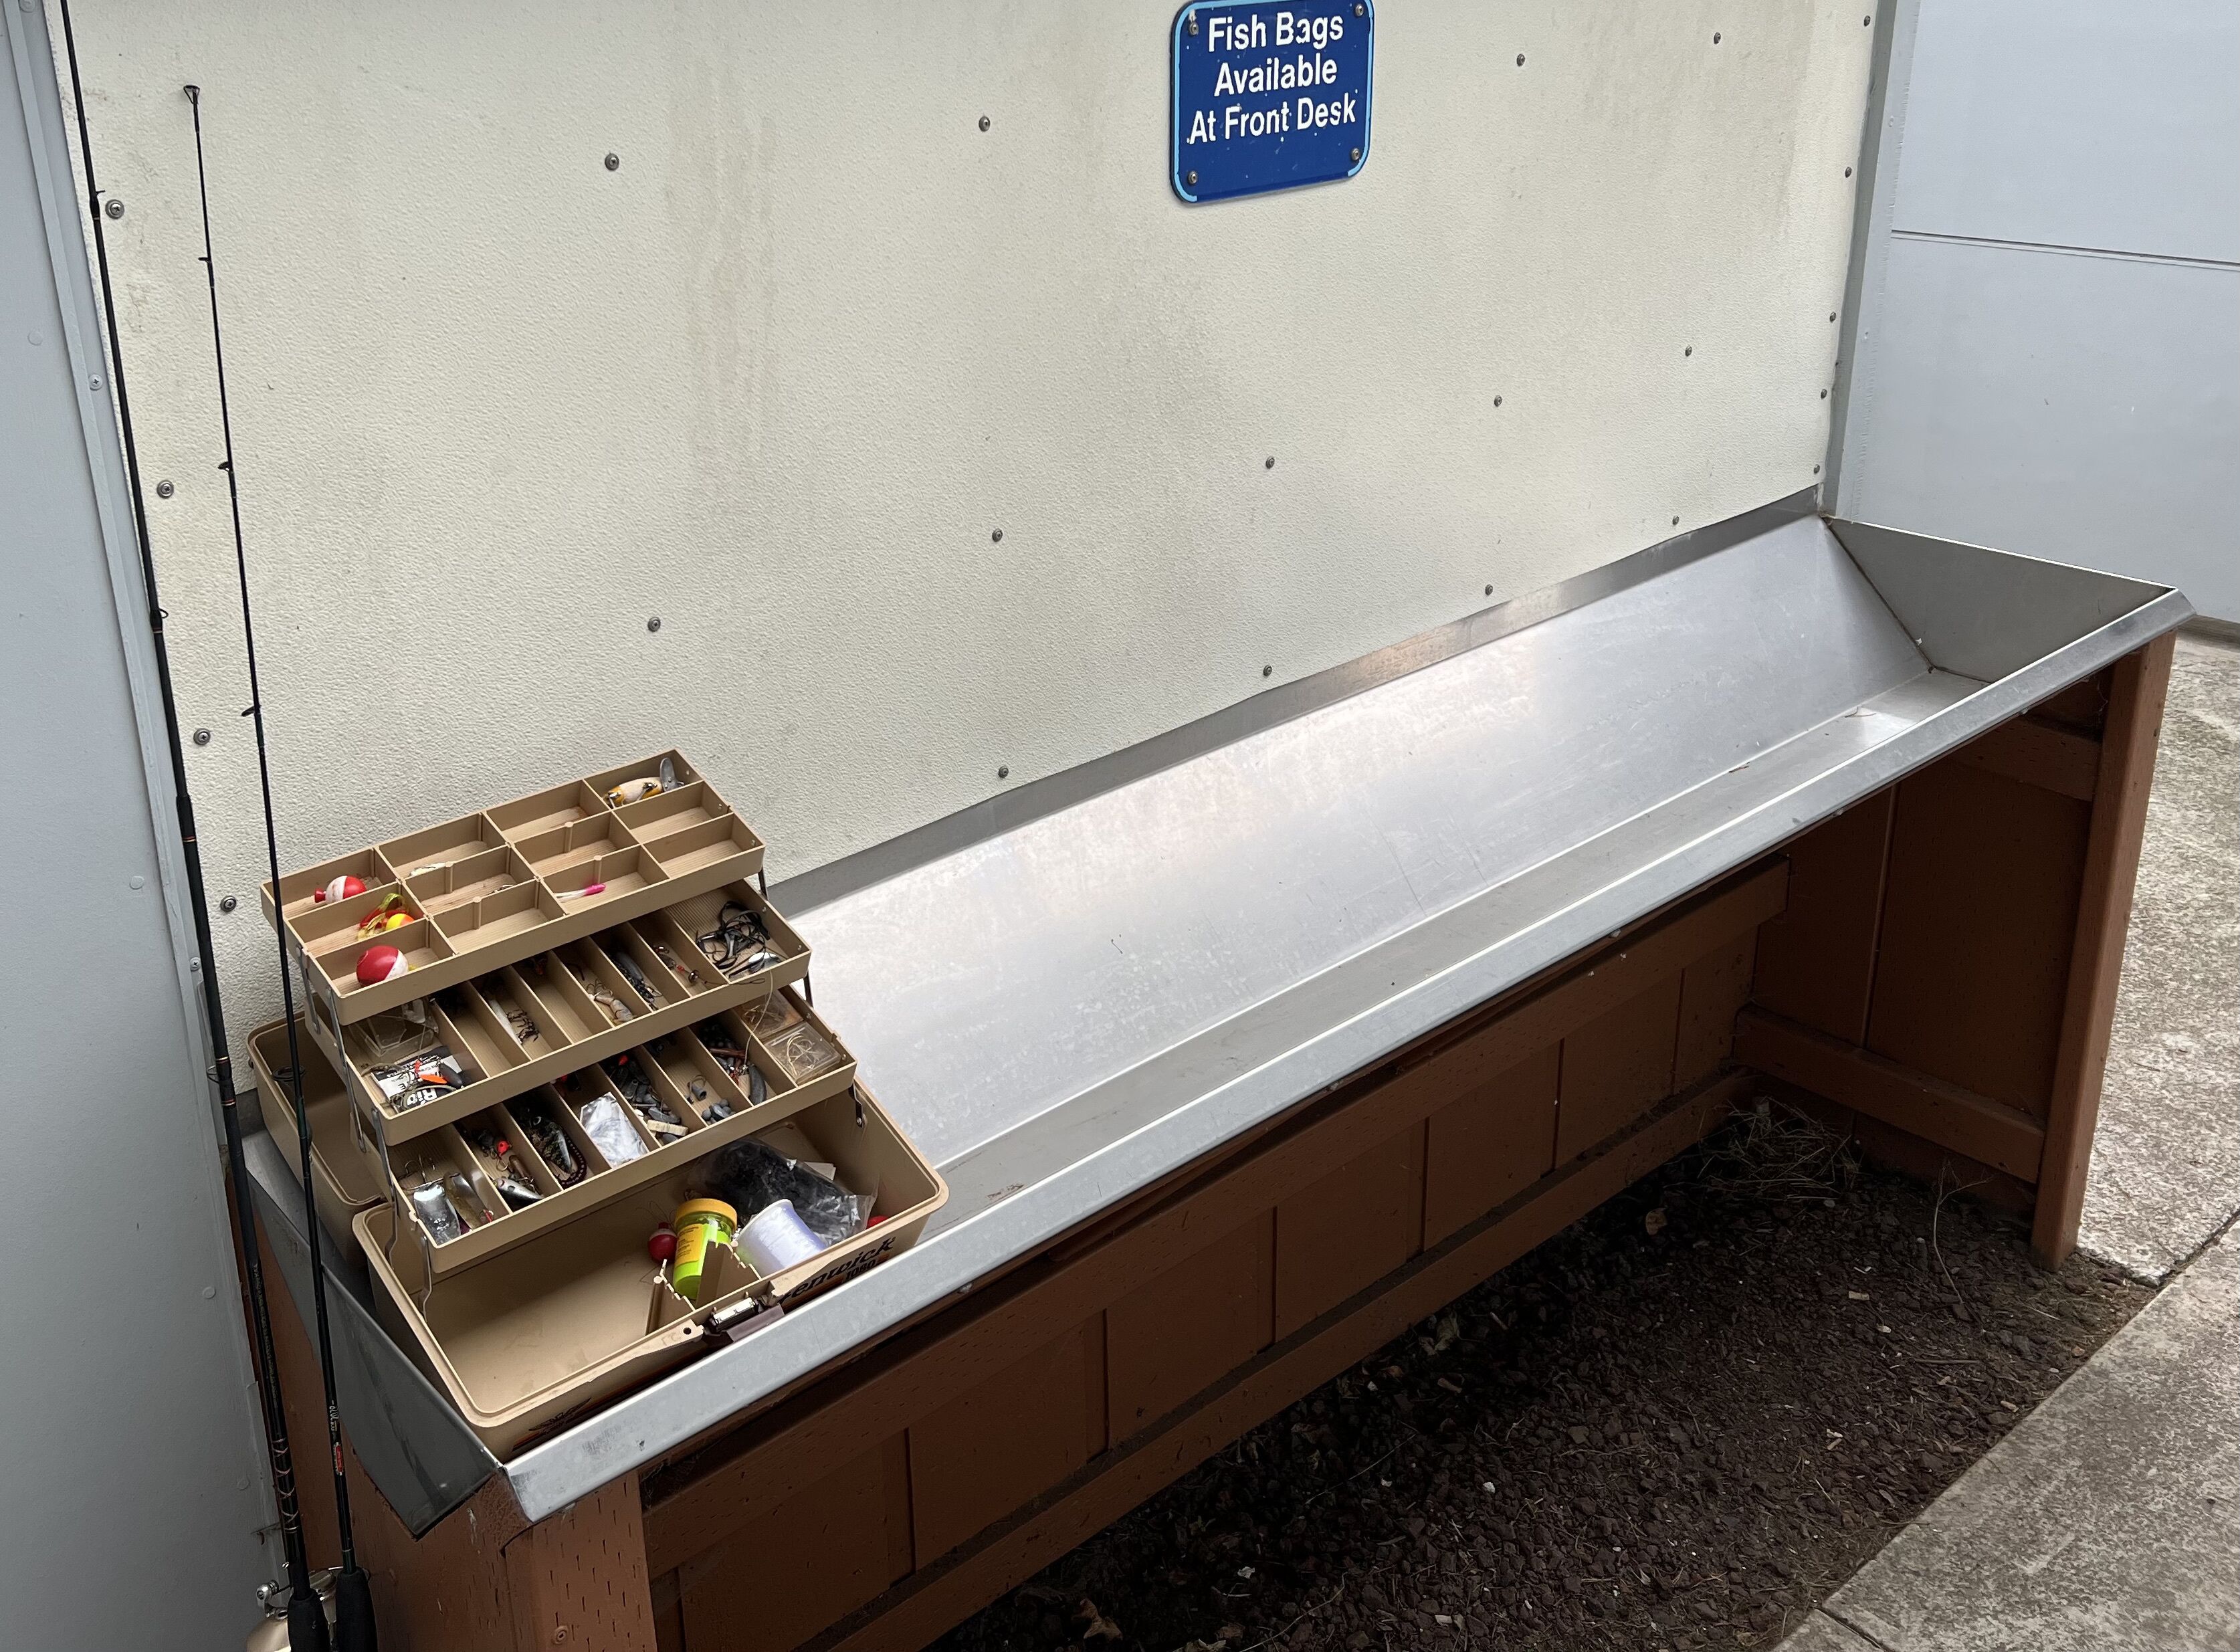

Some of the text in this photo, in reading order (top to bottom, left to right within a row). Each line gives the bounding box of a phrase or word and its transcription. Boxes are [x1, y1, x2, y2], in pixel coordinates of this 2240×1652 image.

[1209, 11, 1344, 52] Fish Bags
[1214, 53, 1338, 96] Available
[1189, 92, 1356, 144] At Front Desk
